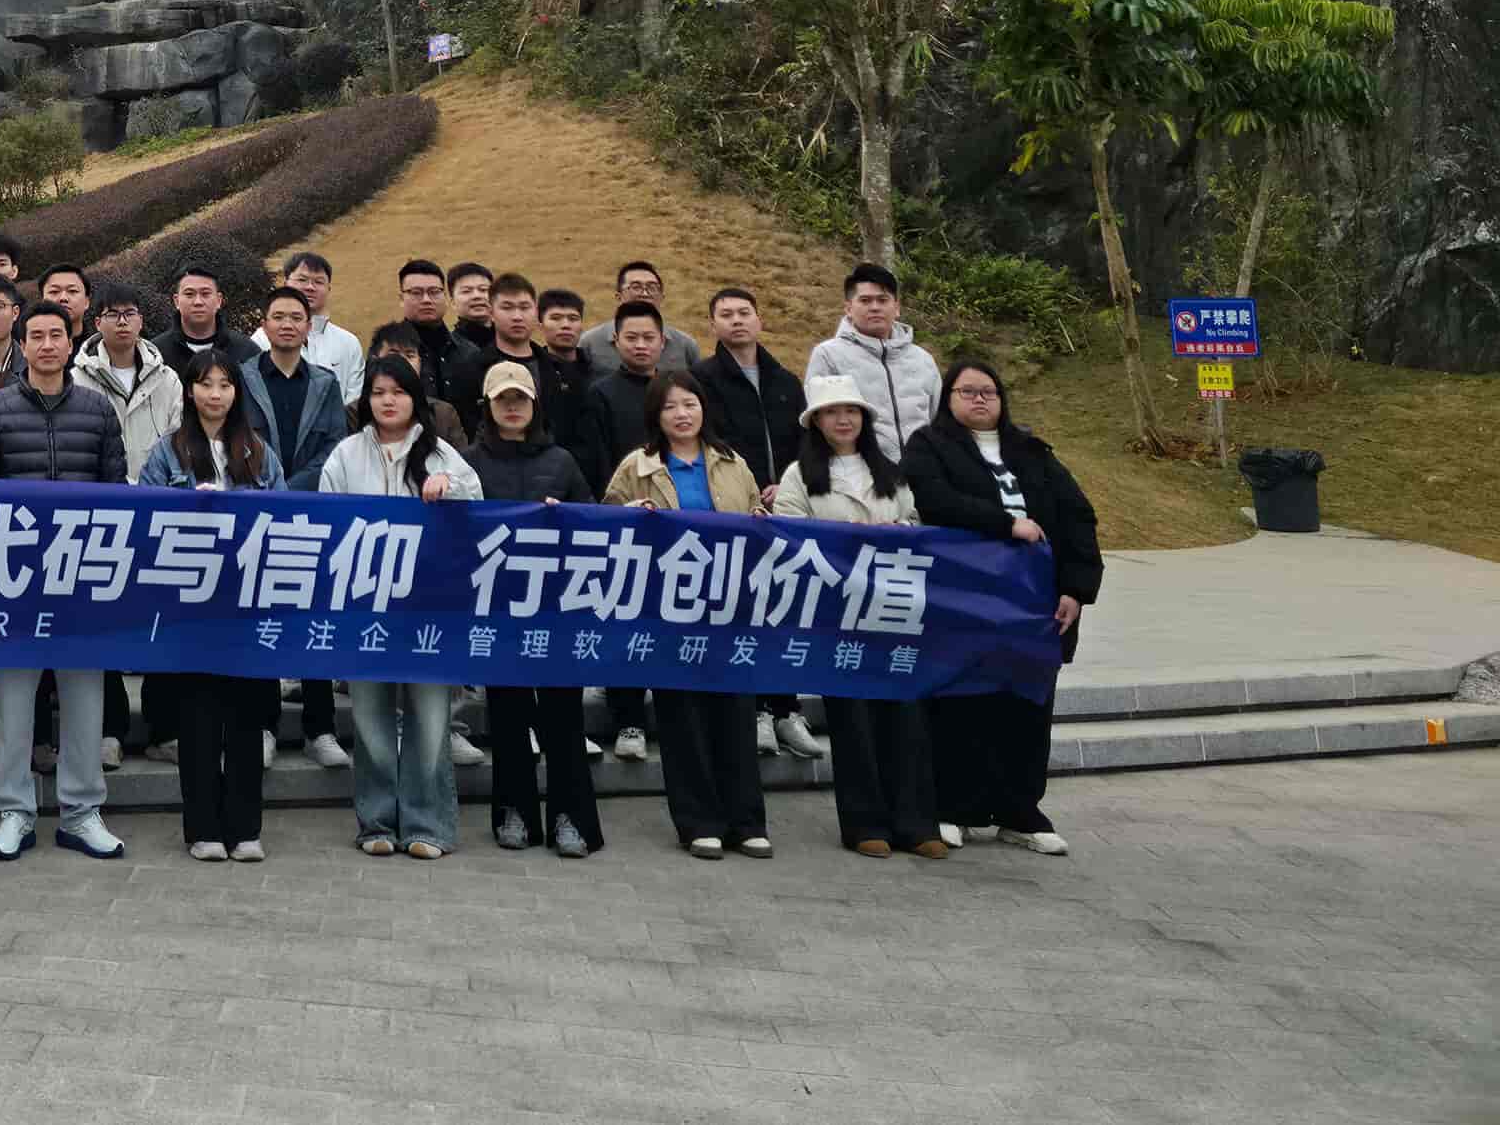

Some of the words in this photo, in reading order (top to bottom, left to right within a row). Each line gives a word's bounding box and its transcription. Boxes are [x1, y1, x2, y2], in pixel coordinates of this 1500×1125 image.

[1200, 309, 1251, 326] 严禁攀爬
[1217, 328, 1248, 339] Climbing
[470, 523, 933, 636] 行动创价值
[255, 619, 921, 674] 专注企业管理软件研发与销售
